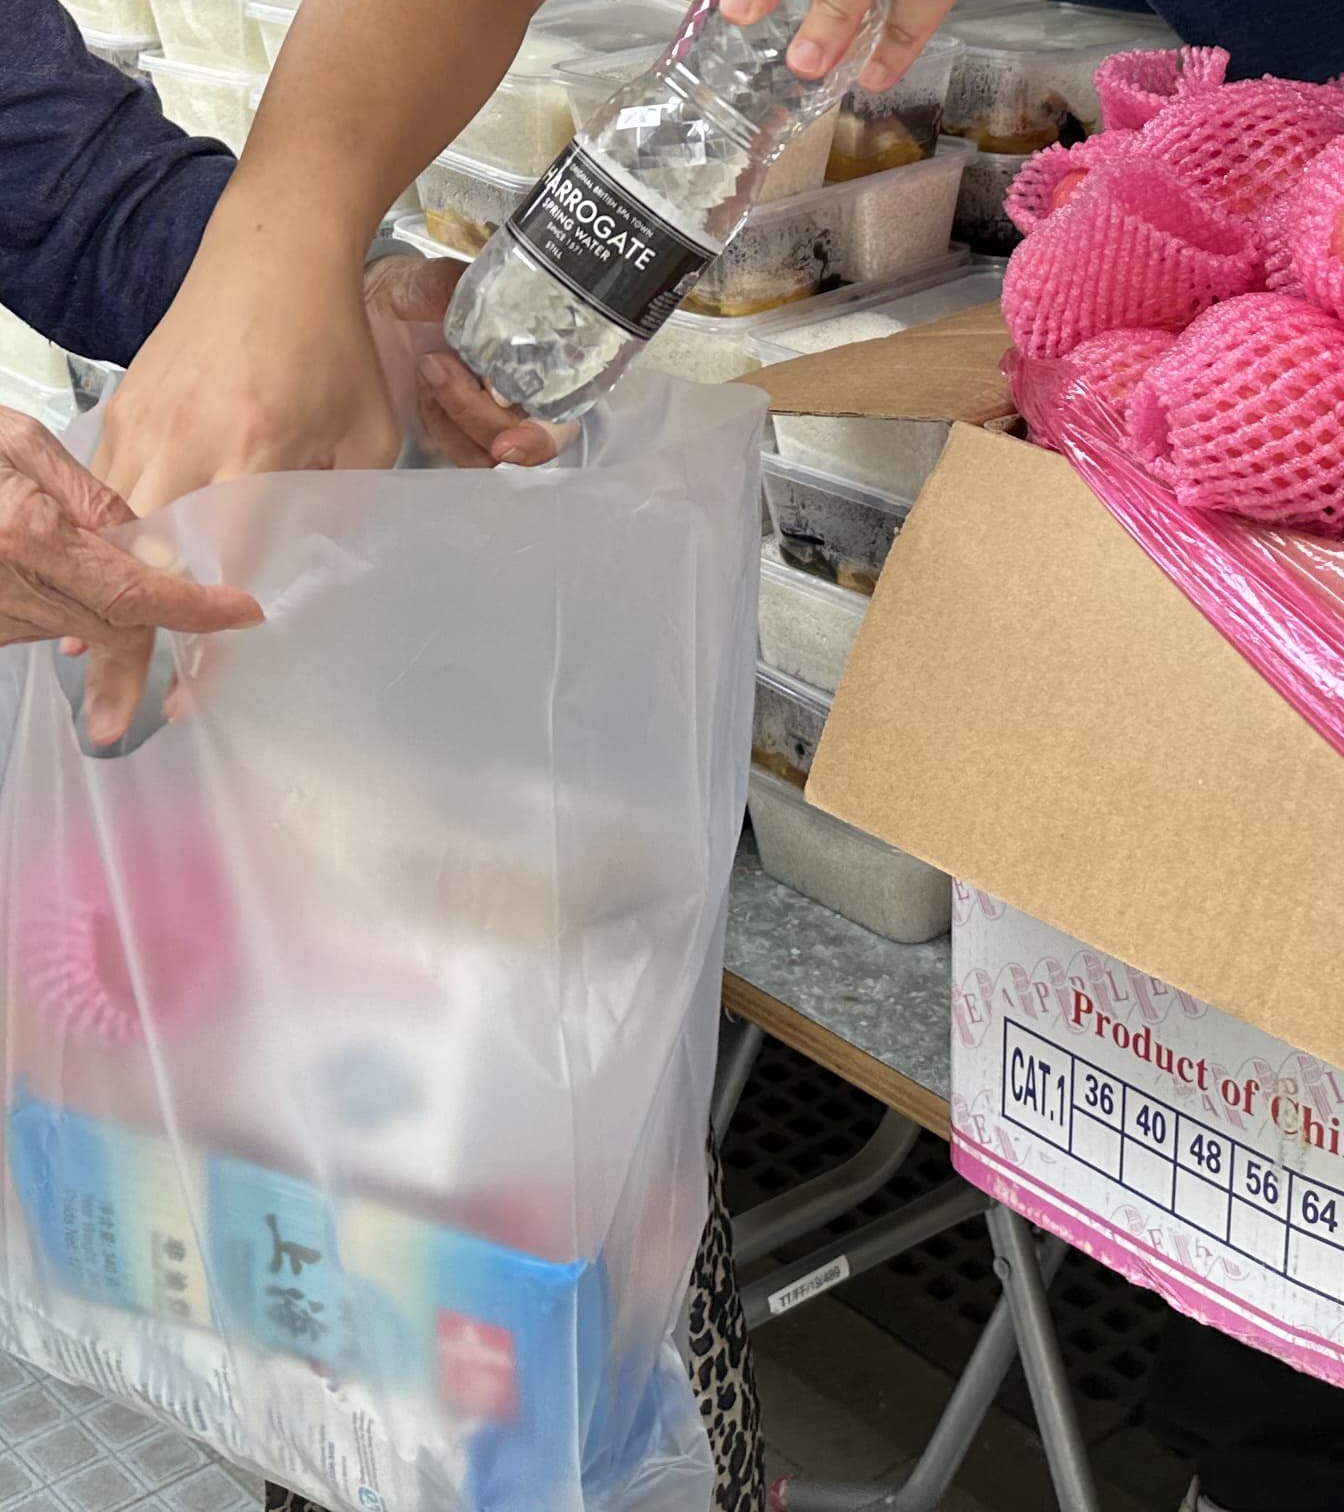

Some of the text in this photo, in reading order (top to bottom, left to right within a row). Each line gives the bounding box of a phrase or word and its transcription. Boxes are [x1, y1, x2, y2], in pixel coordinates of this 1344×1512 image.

[542, 196, 611, 262] SPRING WATER
[543, 167, 656, 271] HARROGATE
[616, 204, 631, 221] SPA
[630, 216, 655, 238] TOWN
[1069, 988, 1209, 1093] Product
[1221, 1071, 1260, 1118] of
[1009, 1045, 1066, 1128] CAT.1
[1084, 1073, 1115, 1116] 36
[1135, 1109, 1167, 1144] 40
[1189, 1133, 1223, 1174] 48
[1245, 1163, 1280, 1205] 56
[1301, 1191, 1338, 1233] 64
